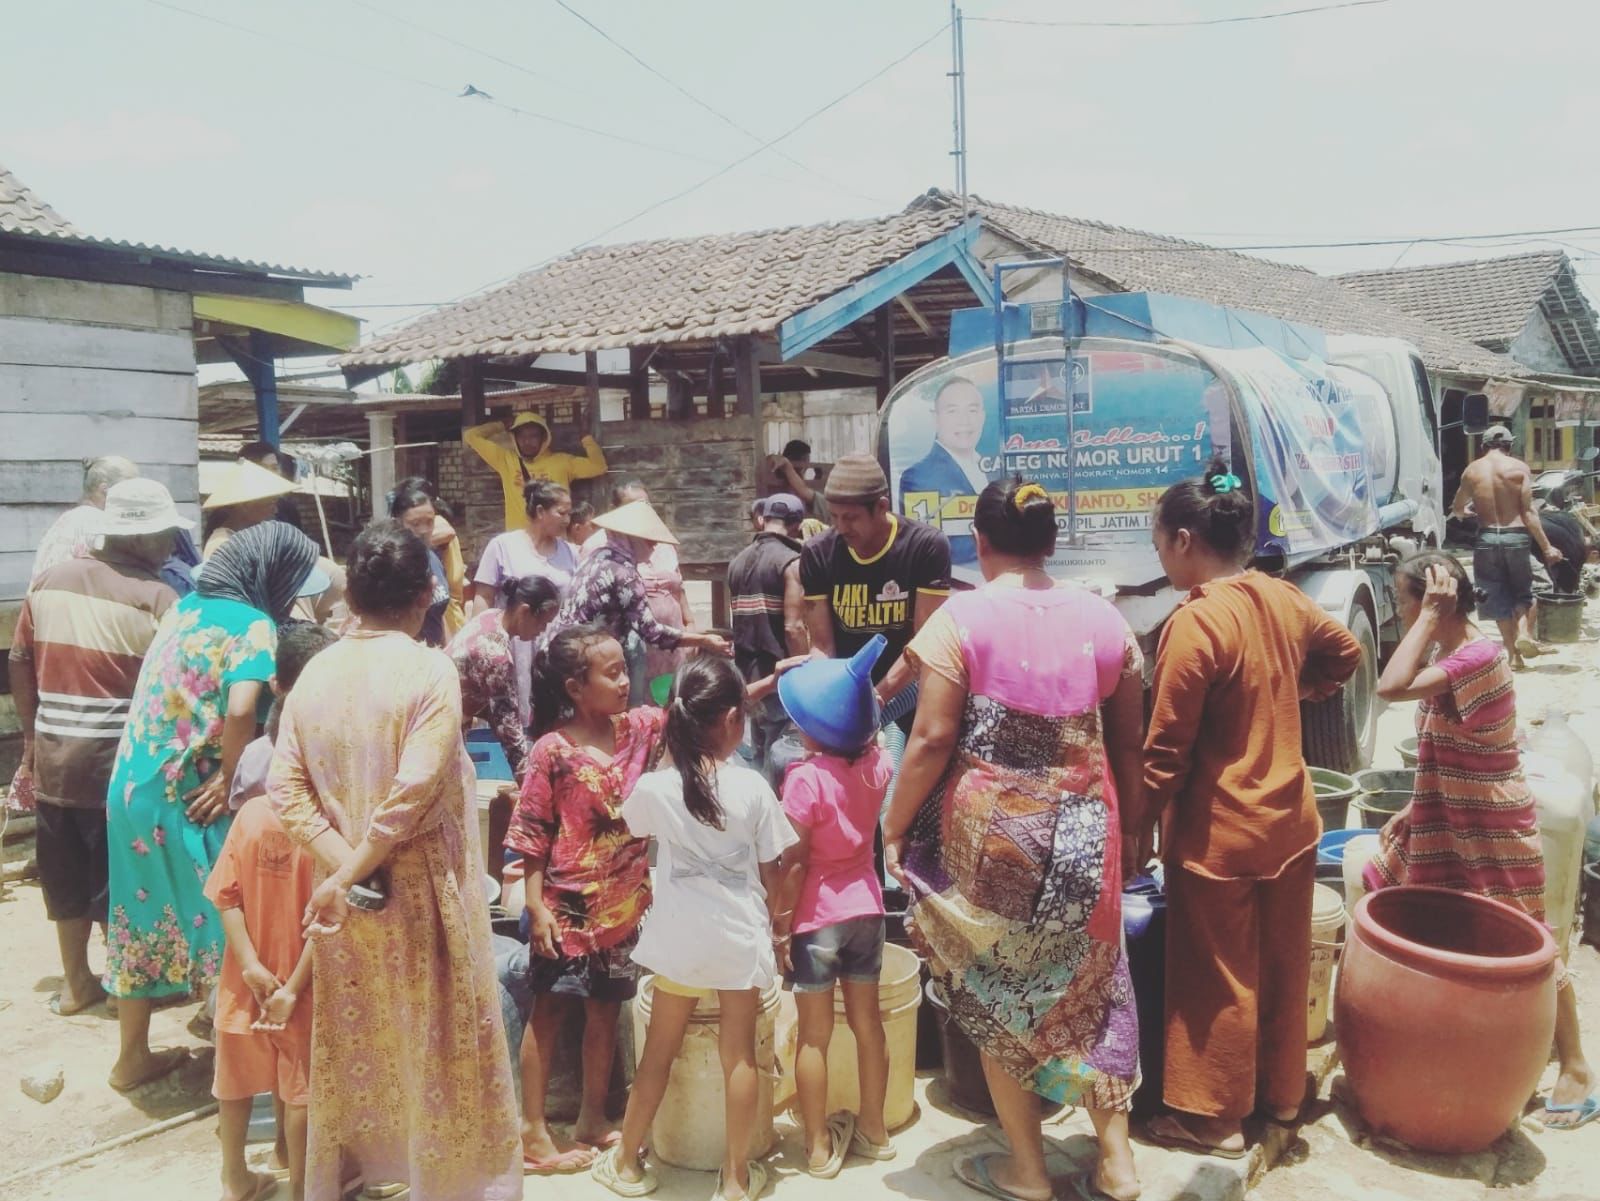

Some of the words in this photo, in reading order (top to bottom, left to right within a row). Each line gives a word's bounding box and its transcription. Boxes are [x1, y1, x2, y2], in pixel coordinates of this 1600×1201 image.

[979, 455, 1040, 473] CALEG
[1127, 445, 1184, 464] URUT
[1192, 445, 1201, 461] 1
[1116, 468, 1152, 476] NOMOR
[1155, 465, 1169, 474] 14
[1101, 515, 1140, 529] JATIM
[833, 584, 867, 606] LAKI
